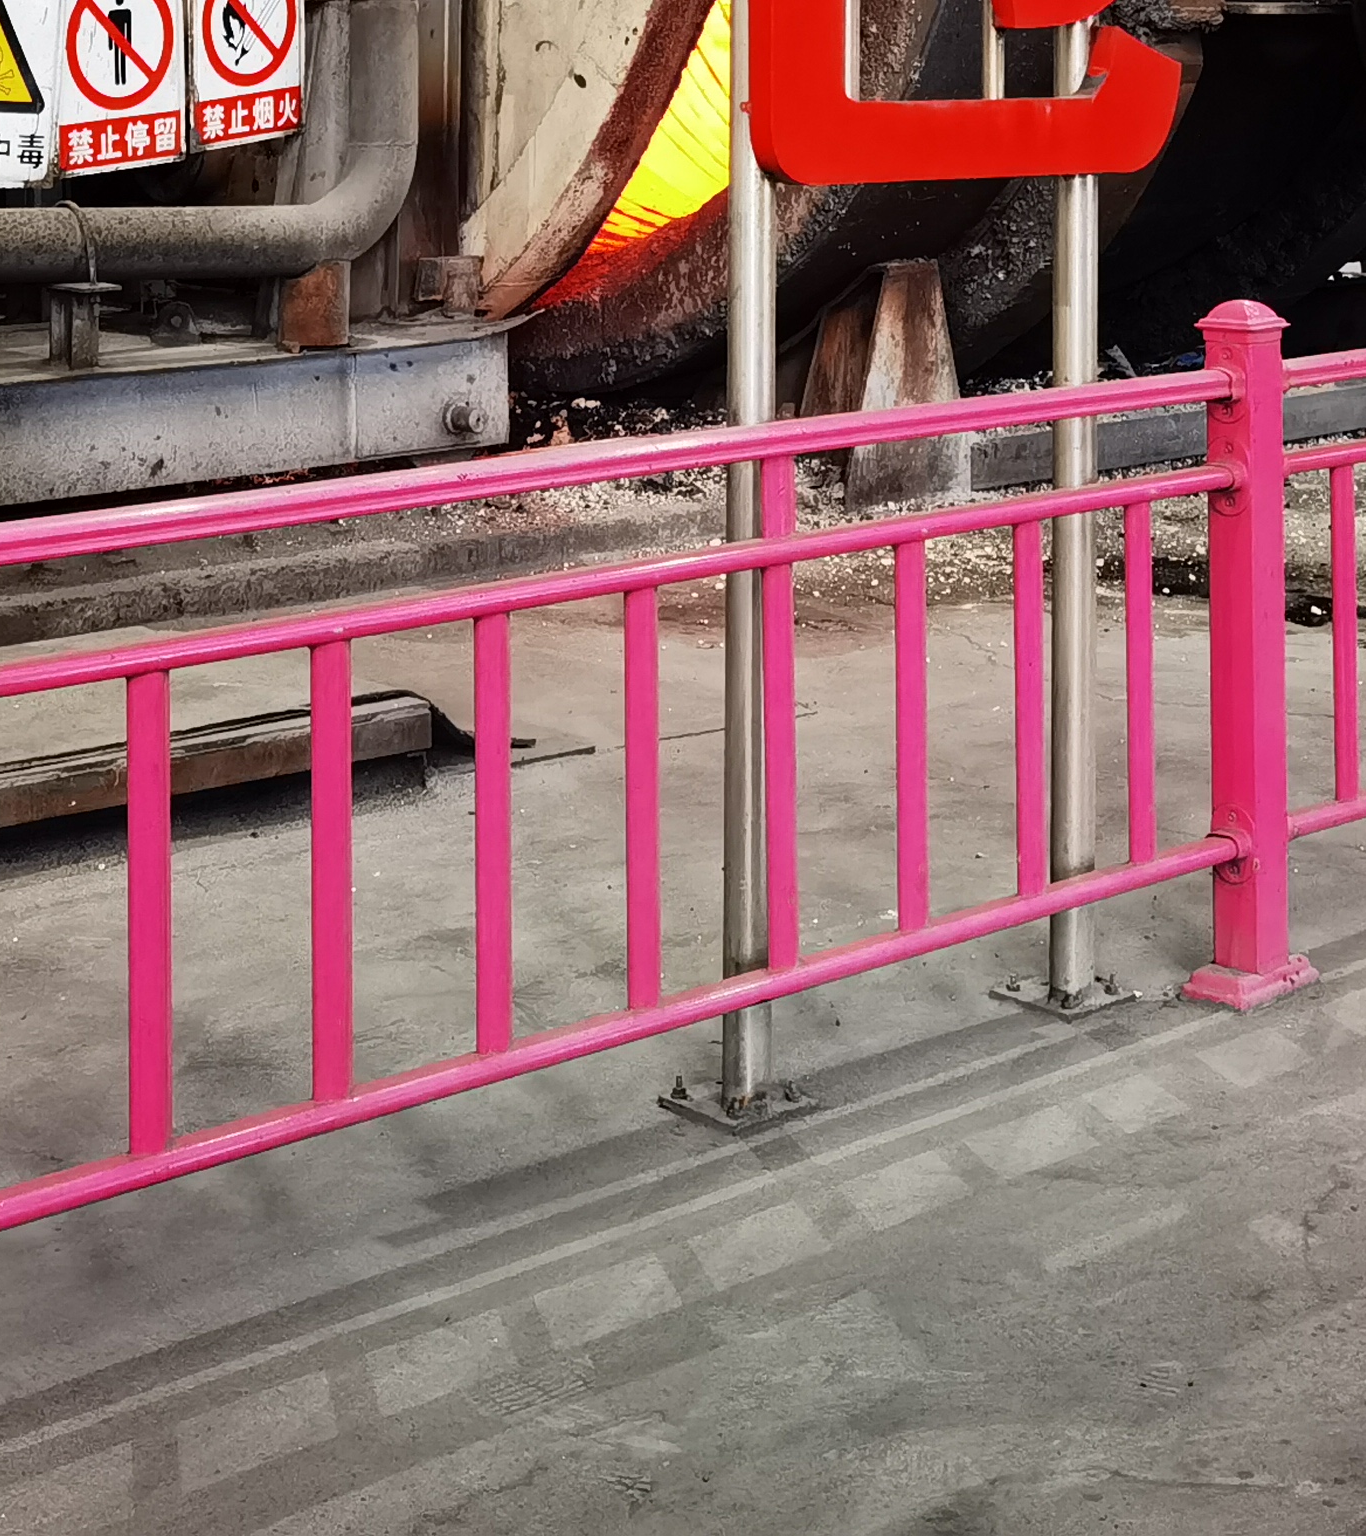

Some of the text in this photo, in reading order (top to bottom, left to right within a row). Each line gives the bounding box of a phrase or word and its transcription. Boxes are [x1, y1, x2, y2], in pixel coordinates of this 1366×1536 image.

[67, 116, 177, 165] 禁止停留
[201, 91, 299, 141] 禁止烟火
